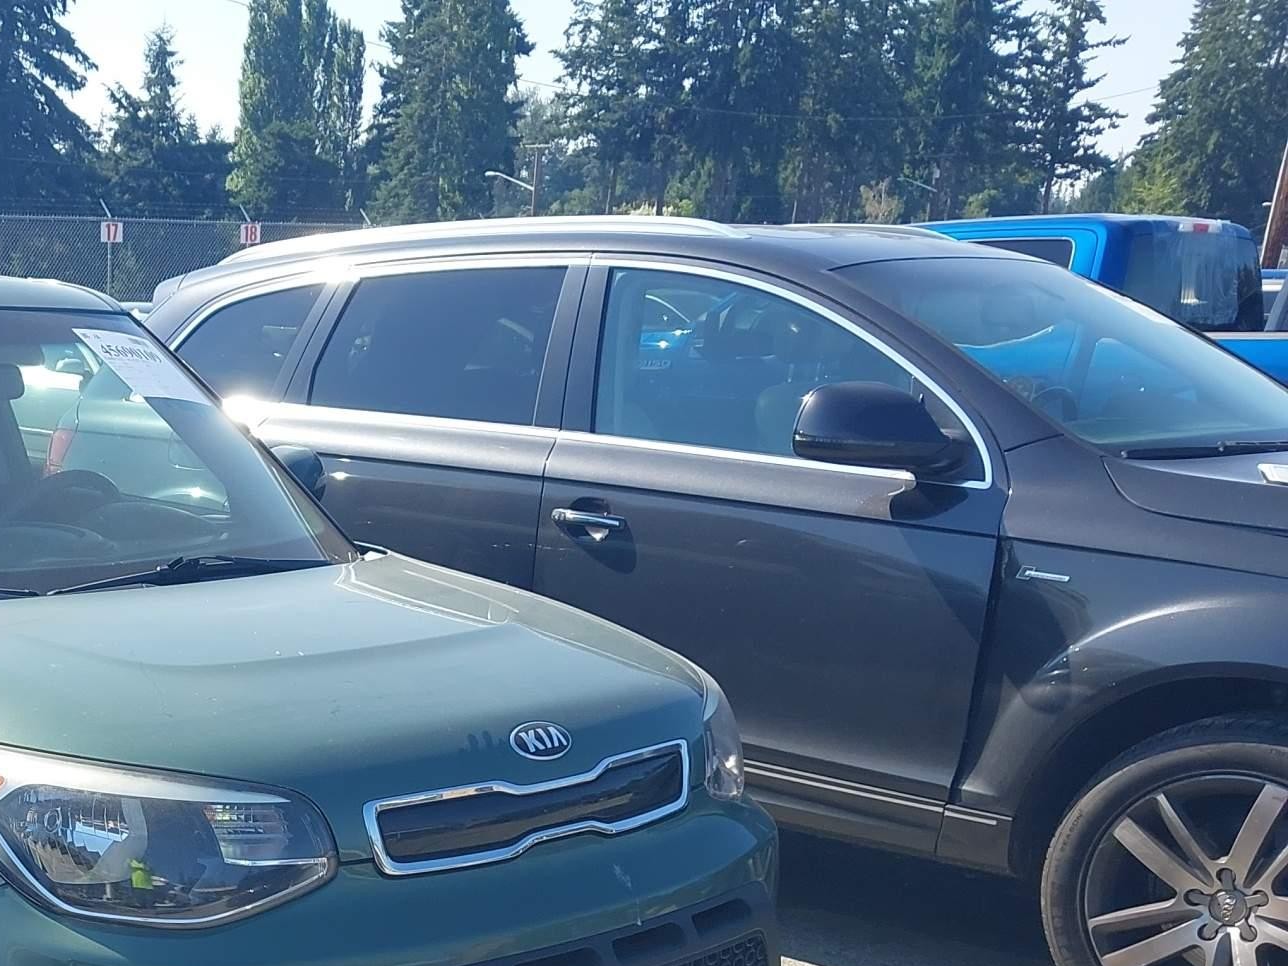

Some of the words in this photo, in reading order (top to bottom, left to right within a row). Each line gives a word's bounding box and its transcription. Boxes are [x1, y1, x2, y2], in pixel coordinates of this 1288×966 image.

[105, 223, 119, 241] 17
[244, 224, 258, 243] 18
[518, 726, 568, 753] KIA
